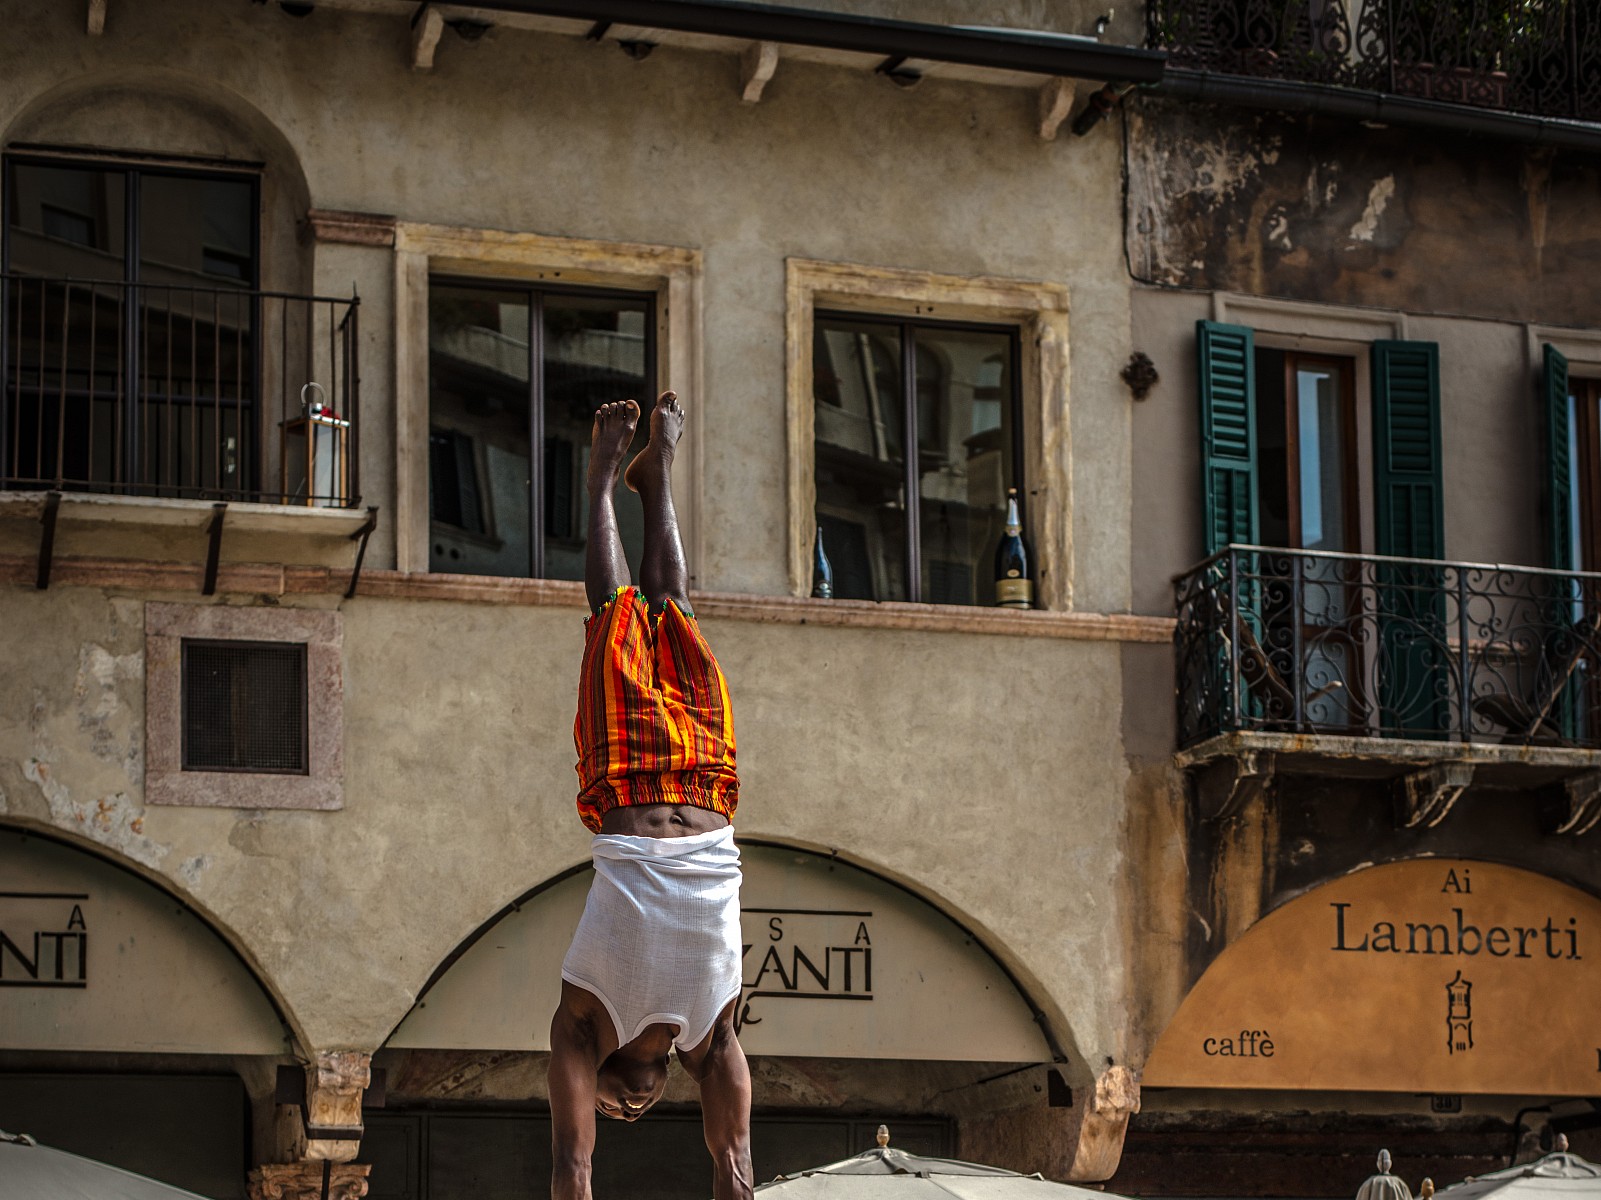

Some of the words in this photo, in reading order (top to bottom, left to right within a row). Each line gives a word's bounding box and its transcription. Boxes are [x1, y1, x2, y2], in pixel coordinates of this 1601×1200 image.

[1441, 868, 1473, 895] Ai
[1329, 902, 1583, 961] Lamberti
[1203, 1030, 1275, 1057] caffè
